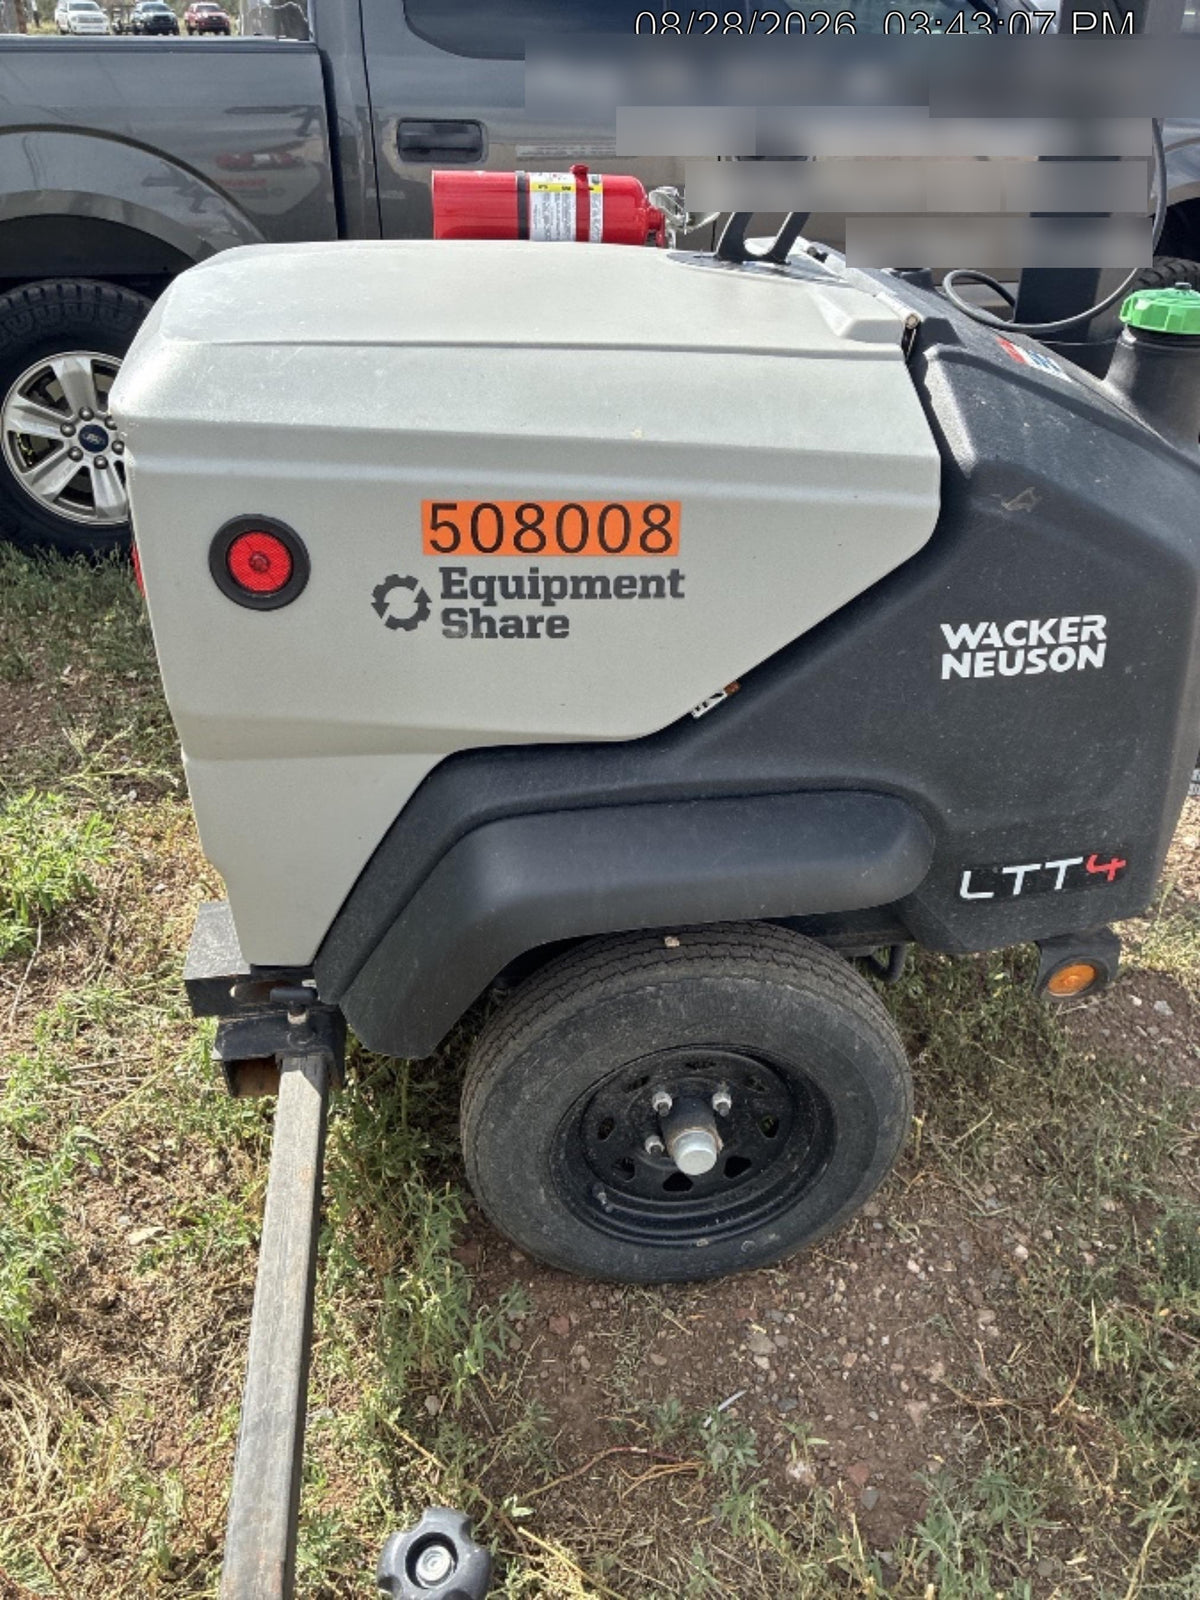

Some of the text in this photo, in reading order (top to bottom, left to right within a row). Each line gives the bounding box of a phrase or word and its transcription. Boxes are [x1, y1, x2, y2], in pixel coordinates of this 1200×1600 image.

[430, 503, 673, 554] 508008
[439, 566, 686, 607] Equipment
[440, 607, 570, 639] Share
[940, 614, 1107, 650] WACKER
[941, 642, 1107, 680] NEUSON
